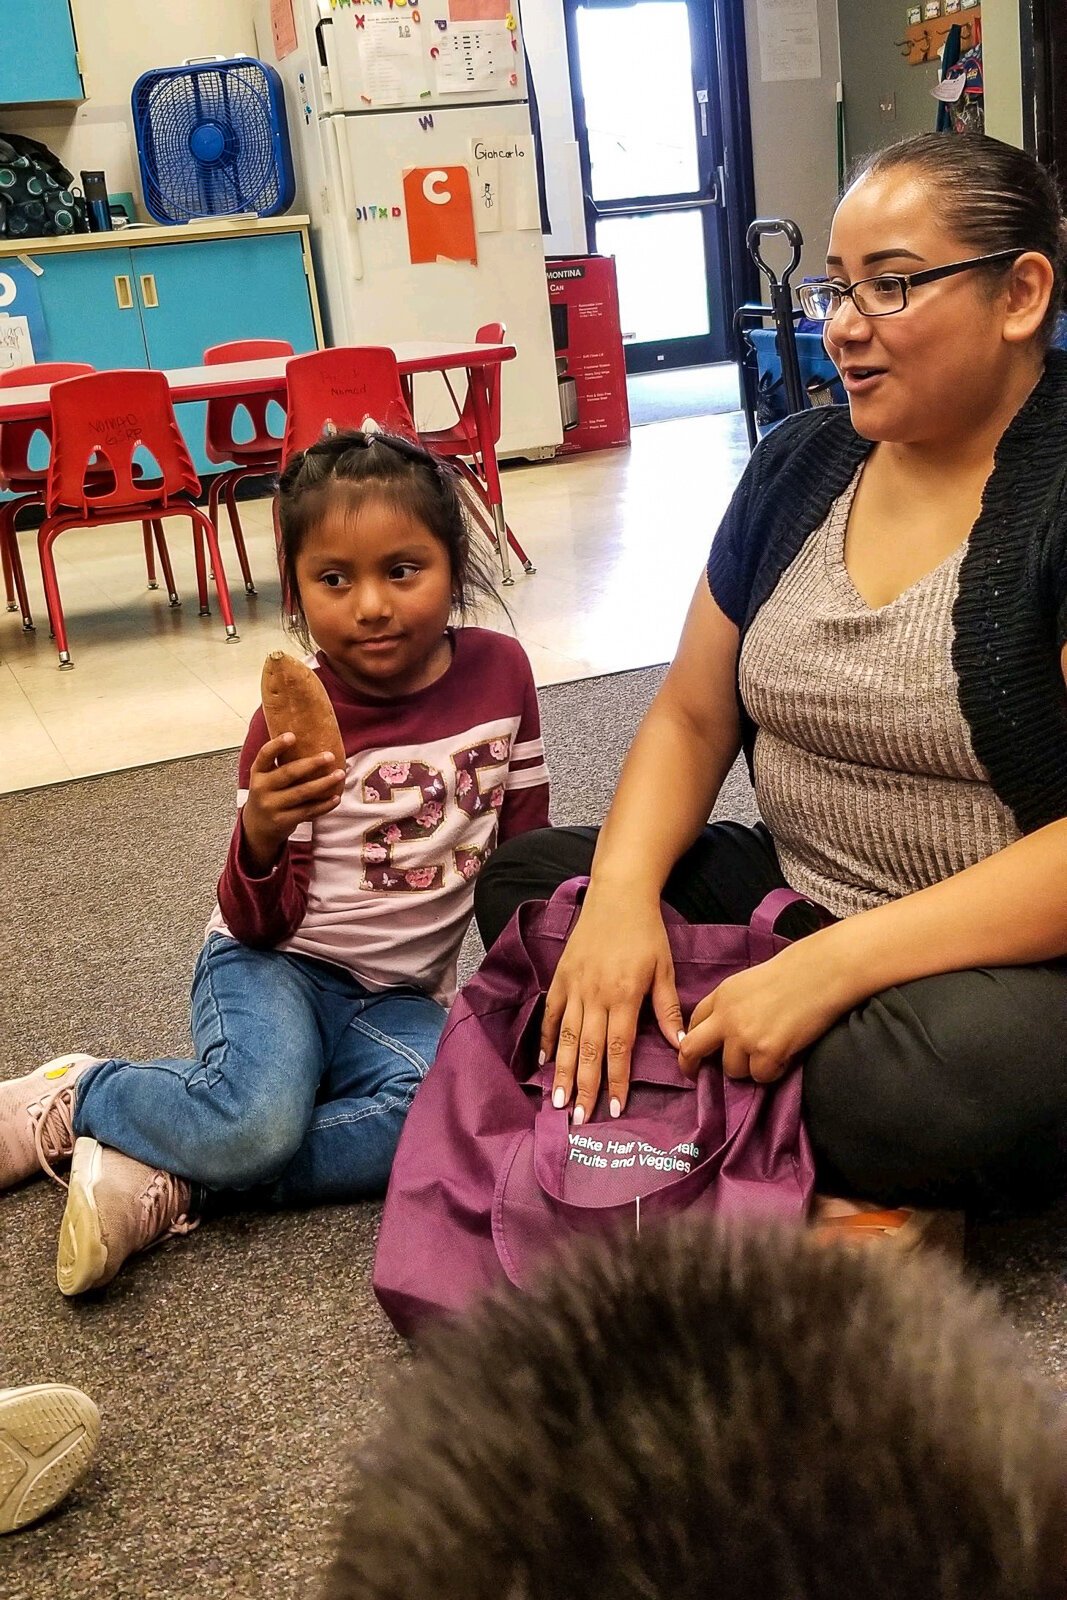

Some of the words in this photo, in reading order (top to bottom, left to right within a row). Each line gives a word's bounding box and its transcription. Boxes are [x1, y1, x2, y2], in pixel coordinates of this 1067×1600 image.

[418, 113, 435, 131] W
[474, 142, 525, 160] Giancarlo
[422, 170, 452, 205] C
[568, 1133, 604, 1152] Make
[606, 1140, 636, 1155] Half
[637, 1141, 668, 1156] Your
[669, 1142, 700, 1158] late
[569, 1148, 608, 1169] Fruits
[610, 1154, 637, 1169] and
[638, 1153, 691, 1174] Veggies
